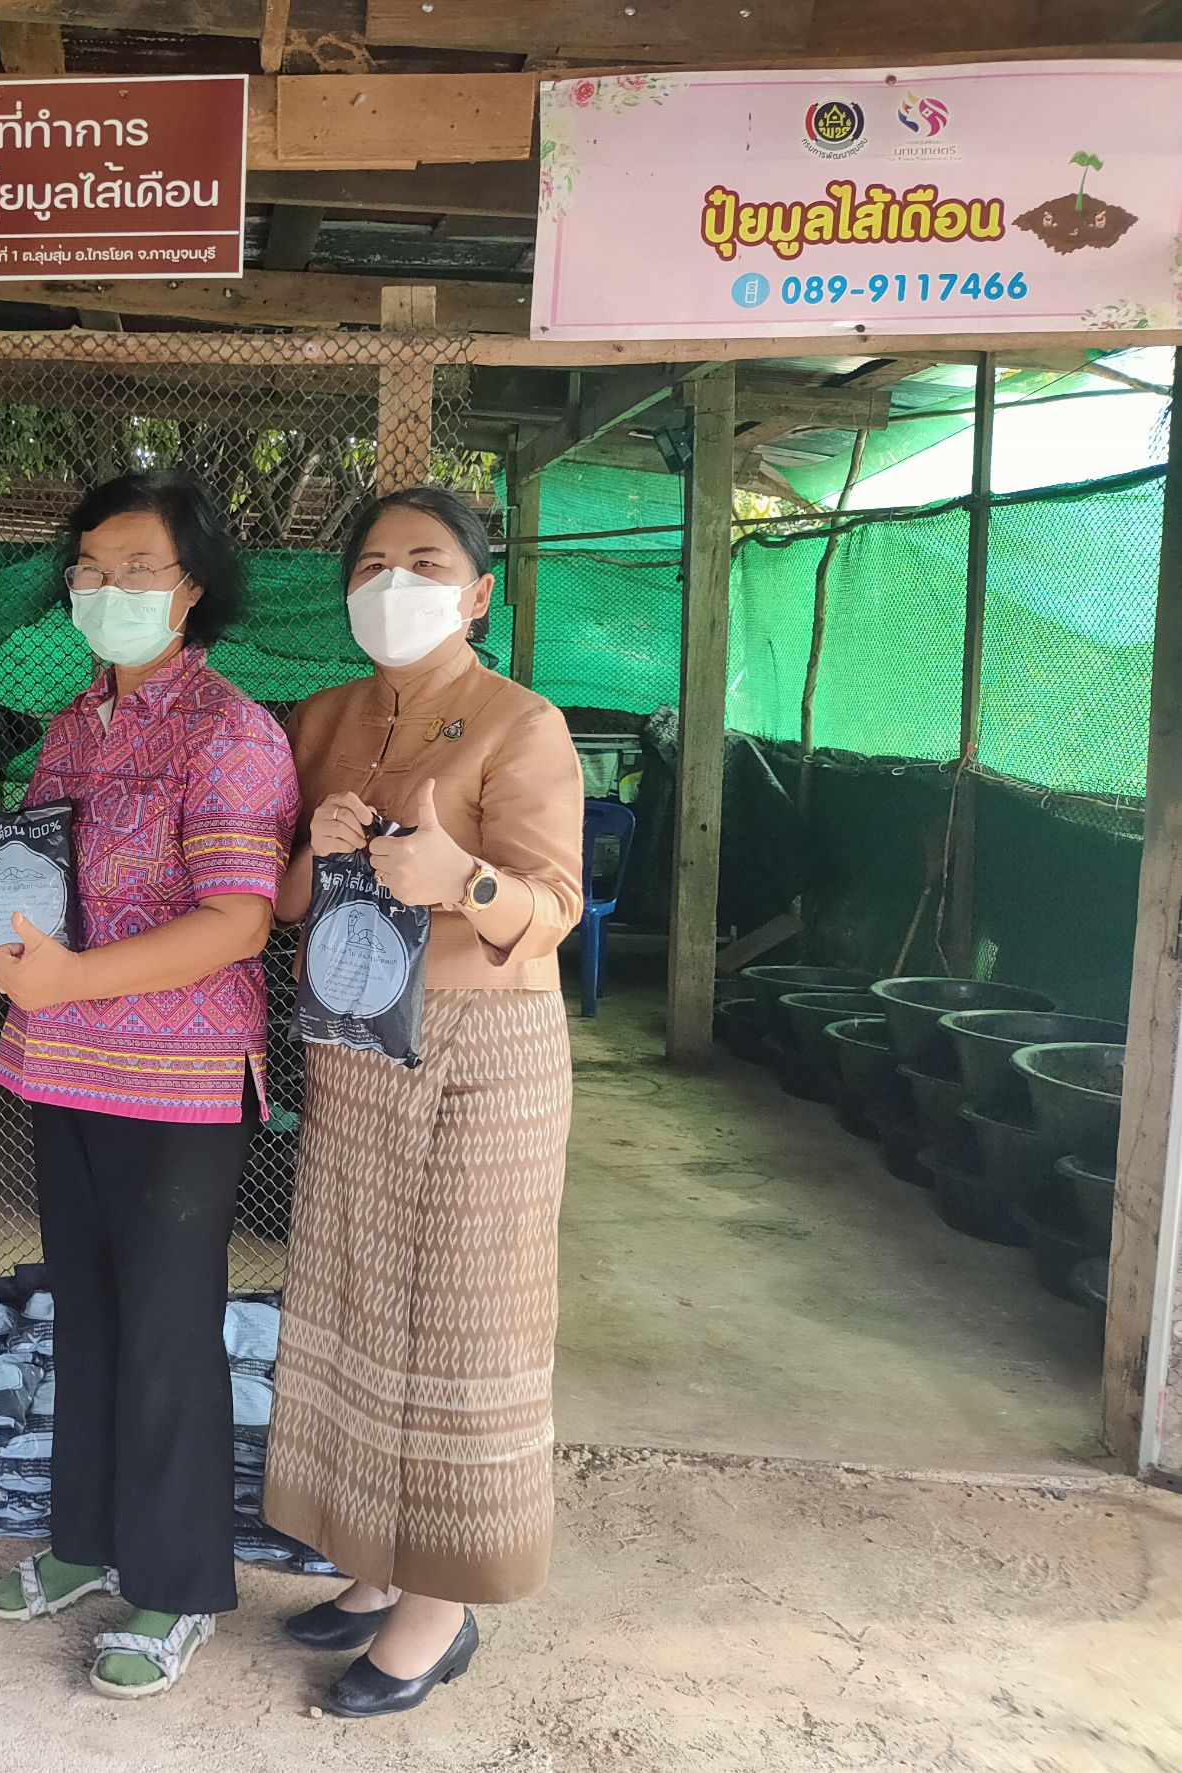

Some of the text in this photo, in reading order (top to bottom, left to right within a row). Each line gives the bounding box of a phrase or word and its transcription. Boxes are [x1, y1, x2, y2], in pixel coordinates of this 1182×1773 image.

[801, 137, 868, 160] กรมการพัฒนาชุมชน
[703, 181, 1004, 260] ปุ๋ยมูลไส้เดือน
[12, 250, 18, 262] 1
[22, 244, 72, 265] ต.ลุ่มสุ่ม
[75, 247, 134, 261] อ.ไทรโยค
[137, 245, 217, 263] จ.กาญจนบุรี
[781, 271, 1028, 304] 089-9117466
[28, 819, 62, 840] 100%
